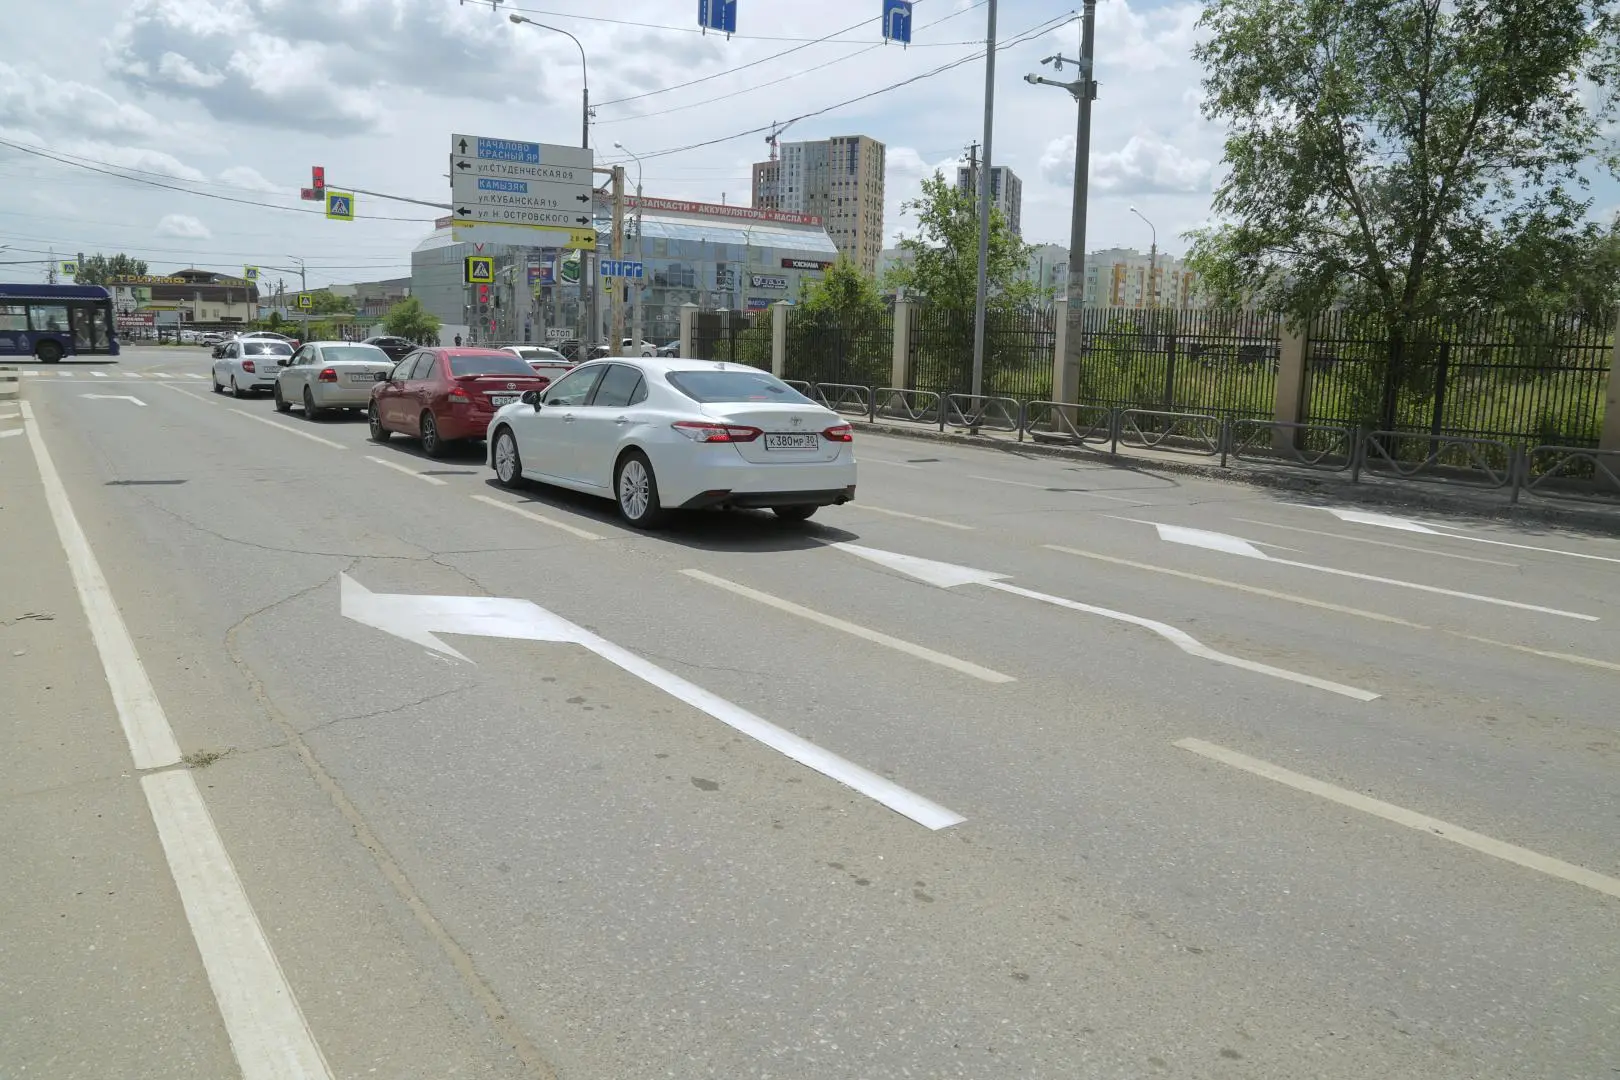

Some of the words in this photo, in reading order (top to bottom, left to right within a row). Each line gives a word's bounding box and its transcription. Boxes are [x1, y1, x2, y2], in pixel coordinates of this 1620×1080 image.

[479, 139, 530, 152] НАЧАЛОВО
[479, 149, 524, 161] КРАСНЫЙ
[526, 153, 538, 163] ЯР
[479, 180, 526, 192] КАМЫЗЯК
[503, 210, 569, 223] ОСТРОВСКОГО
[698, 204, 766, 220] АККУМУЛЯТОРЫ
[774, 213, 802, 223] МАСЛА
[792, 260, 819, 269] YOKOHAMA
[117, 274, 186, 284] ТРИУМФ
